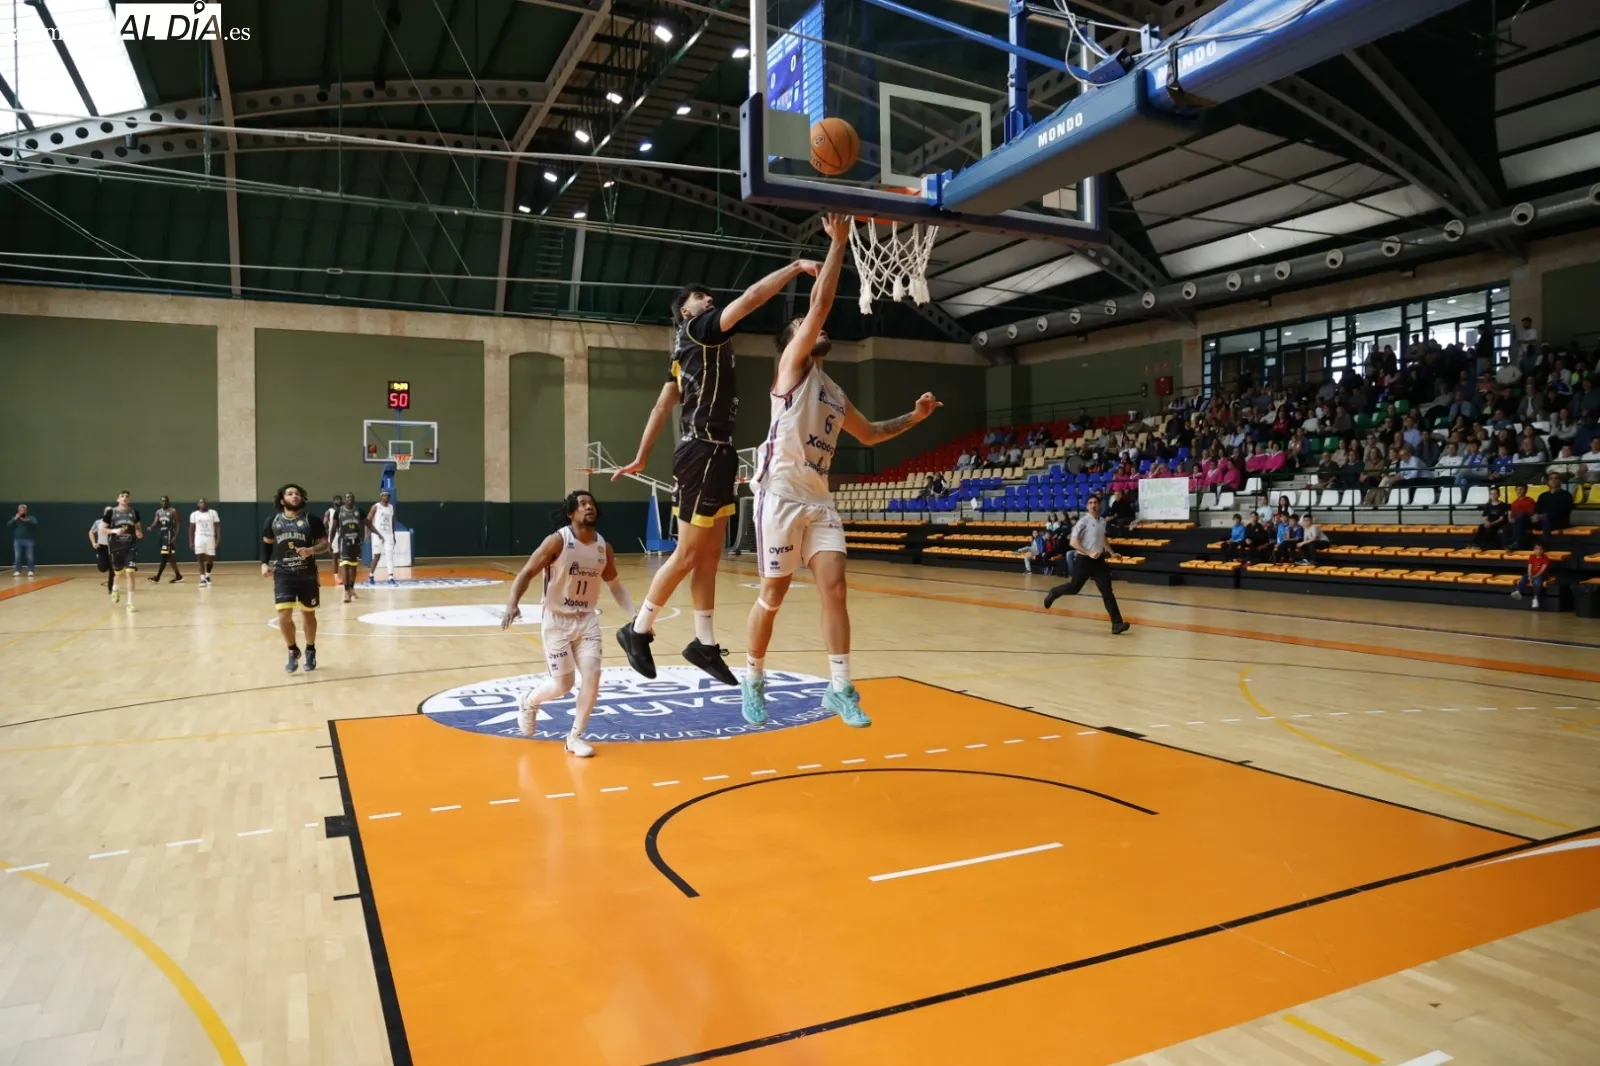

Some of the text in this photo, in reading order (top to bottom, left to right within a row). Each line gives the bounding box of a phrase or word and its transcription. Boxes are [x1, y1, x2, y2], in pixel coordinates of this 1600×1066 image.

[1156, 40, 1217, 89] MNDO
[1037, 112, 1083, 148] MONDO
[389, 392, 408, 407] 50
[824, 414, 836, 435] 6
[287, 541, 295, 550] 5
[575, 580, 588, 596] 11
